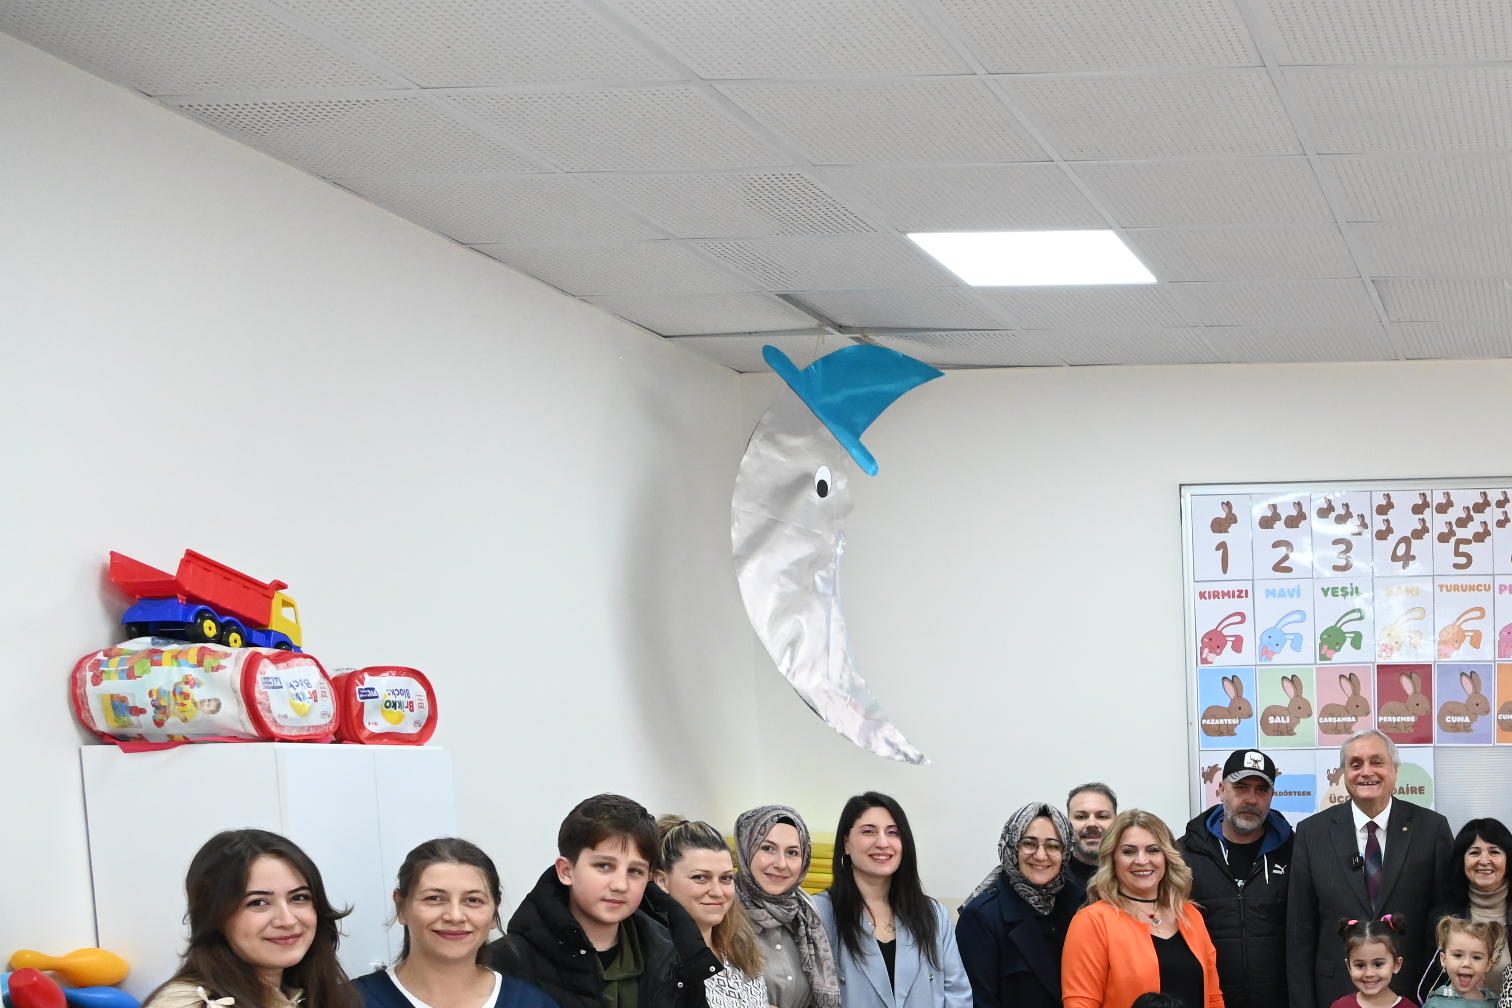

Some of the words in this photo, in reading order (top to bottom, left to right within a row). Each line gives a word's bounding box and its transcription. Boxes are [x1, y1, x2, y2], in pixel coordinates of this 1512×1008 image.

[1215, 540, 1229, 575] 1
[1271, 539, 1294, 573] 2
[1331, 538, 1353, 572] 3
[1391, 535, 1416, 570] 4
[1452, 537, 1473, 570] 5
[1199, 588, 1249, 600] KIRMIZI
[1265, 584, 1303, 599] MAVİ
[1320, 583, 1361, 600] YEŞİL
[1438, 584, 1492, 593] TURUNCU
[384, 700, 415, 712] Brikko
[1201, 717, 1239, 725] PAZARTESİ
[1268, 715, 1290, 724] SALI
[1445, 715, 1471, 723] CUMA
